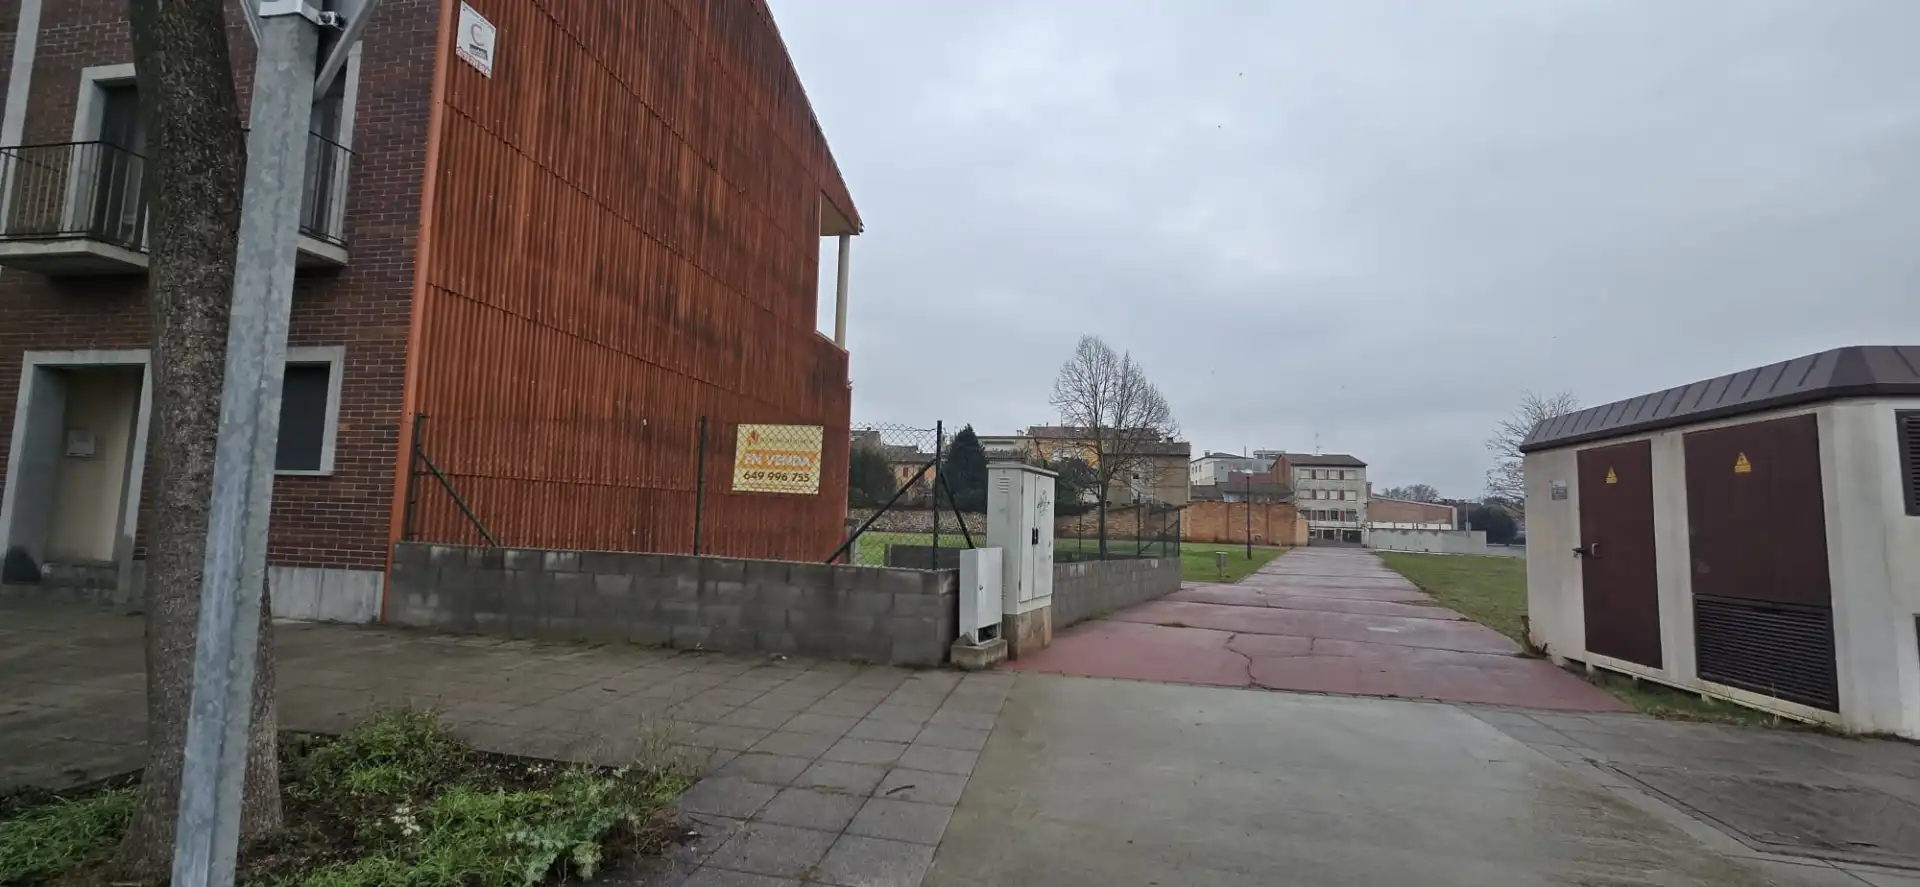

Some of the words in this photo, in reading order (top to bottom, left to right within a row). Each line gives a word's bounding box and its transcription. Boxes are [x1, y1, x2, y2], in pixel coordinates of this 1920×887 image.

[744, 453, 761, 465] EN
[766, 454, 810, 467] VENDA
[743, 470, 764, 480] 649
[767, 471, 788, 481] 996
[791, 472, 810, 482] 755
